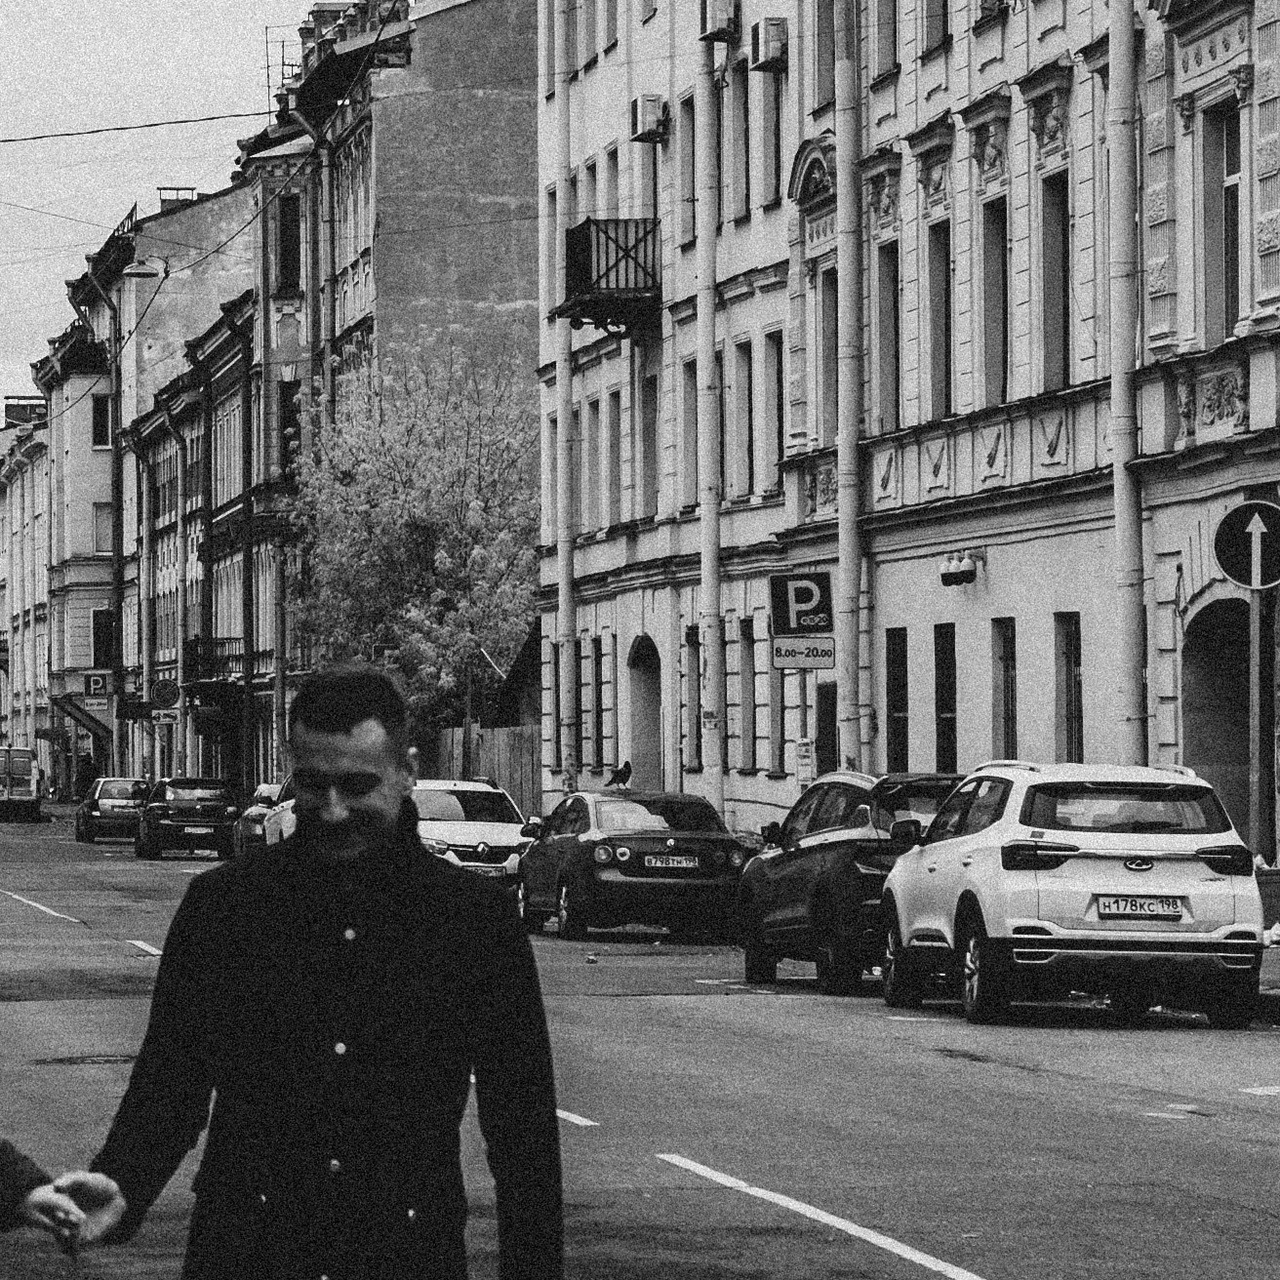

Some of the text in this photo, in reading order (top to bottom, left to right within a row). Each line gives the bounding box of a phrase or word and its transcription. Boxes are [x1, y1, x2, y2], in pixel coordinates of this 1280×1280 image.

[787, 580, 821, 628] P
[90, 676, 103, 694] P
[1103, 899, 1156, 913] Н178КС
